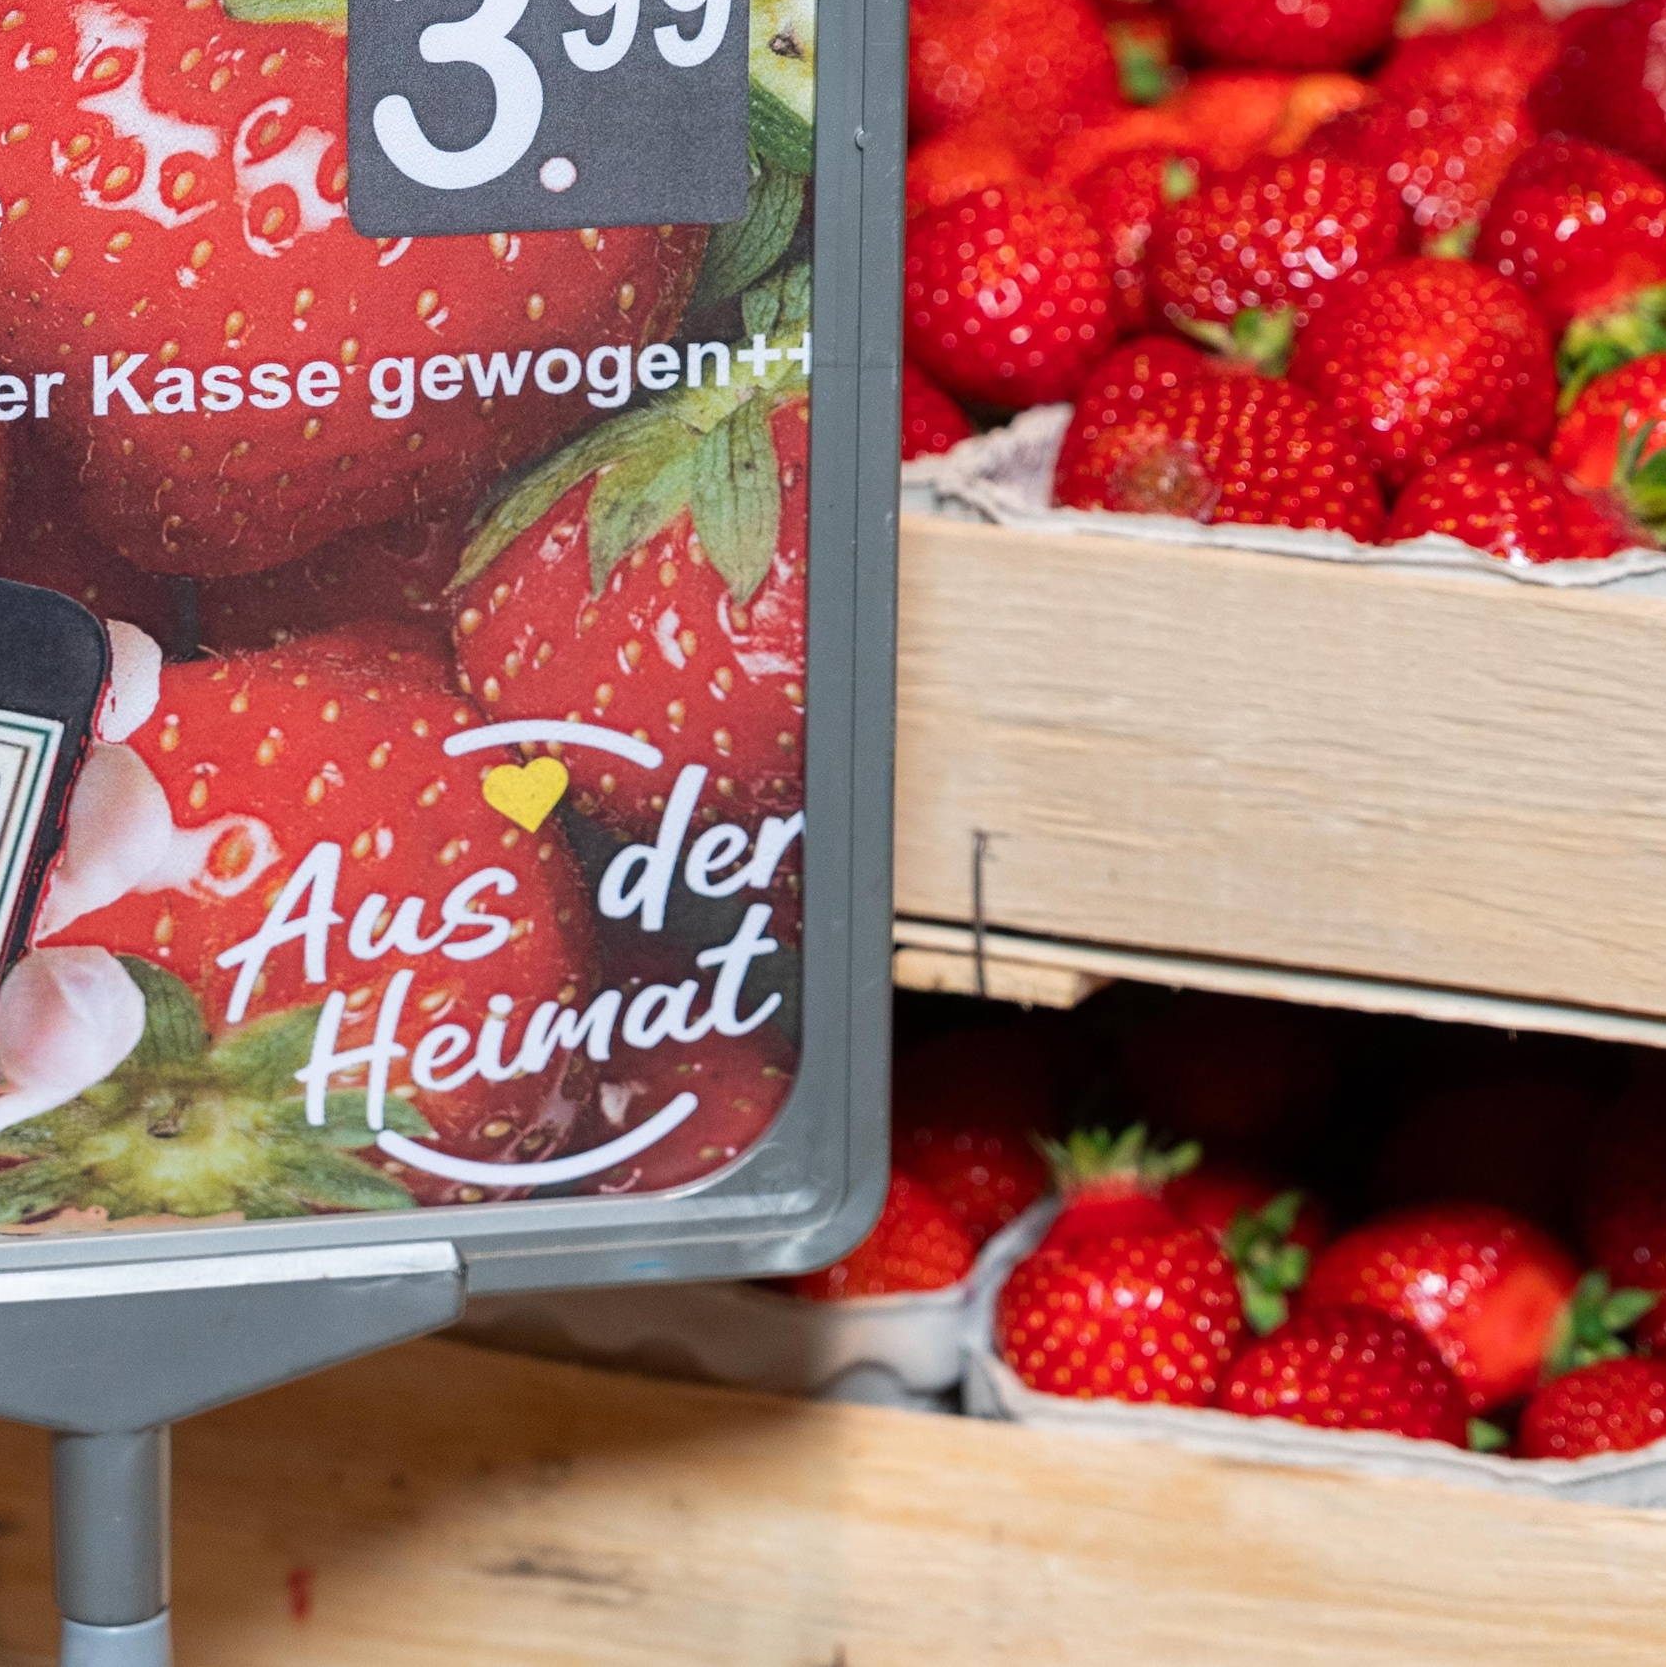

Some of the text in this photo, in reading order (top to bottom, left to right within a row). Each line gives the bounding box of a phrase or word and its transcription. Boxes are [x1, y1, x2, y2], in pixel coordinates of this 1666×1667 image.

[92, 353, 341, 417] Kasse
[215, 763, 806, 1024] Aus der
[294, 903, 783, 1132] Heimat
